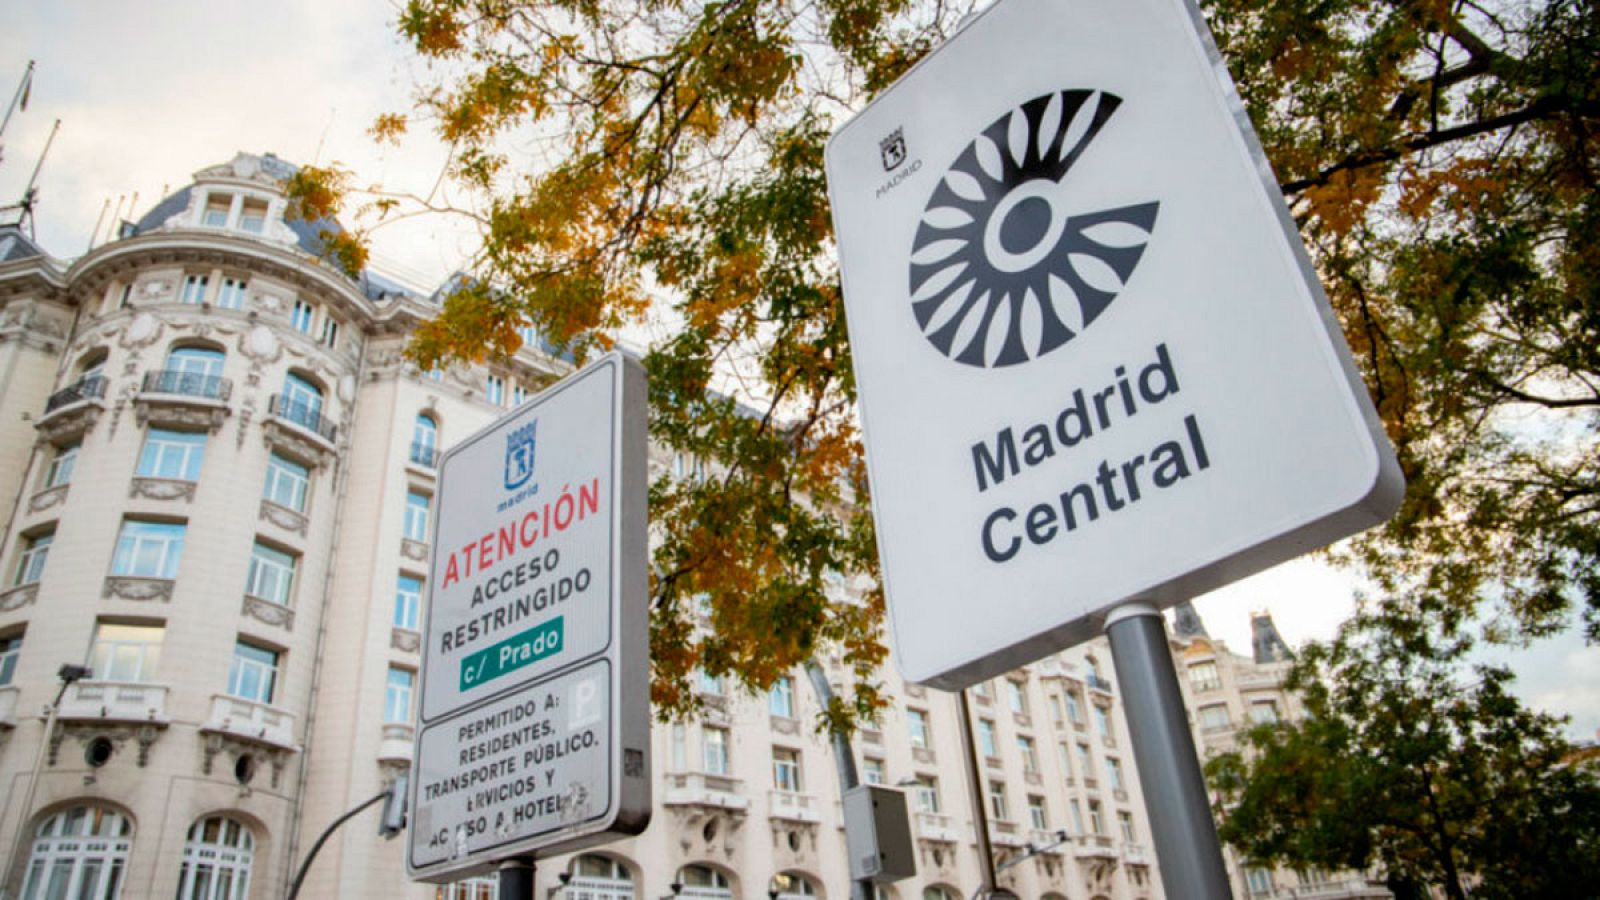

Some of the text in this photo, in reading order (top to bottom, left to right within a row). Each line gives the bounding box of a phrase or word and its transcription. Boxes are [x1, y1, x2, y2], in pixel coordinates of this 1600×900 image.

[876, 160, 922, 199] MADRID
[971, 342, 1180, 493] Madrid
[497, 482, 539, 512] madrid
[981, 413, 1210, 564] Central
[442, 478, 599, 589] ATENCIÓN
[471, 548, 560, 608] ACCESO
[441, 567, 591, 655] RESTRINGIDO
[463, 630, 559, 684] c/ Prado
[458, 693, 560, 743] PERMITIDO A:
[459, 719, 556, 766] RESIDENTES.
[424, 729, 599, 803] TRANSPORTE PÚBLICO.
[545, 768, 555, 788] Y
